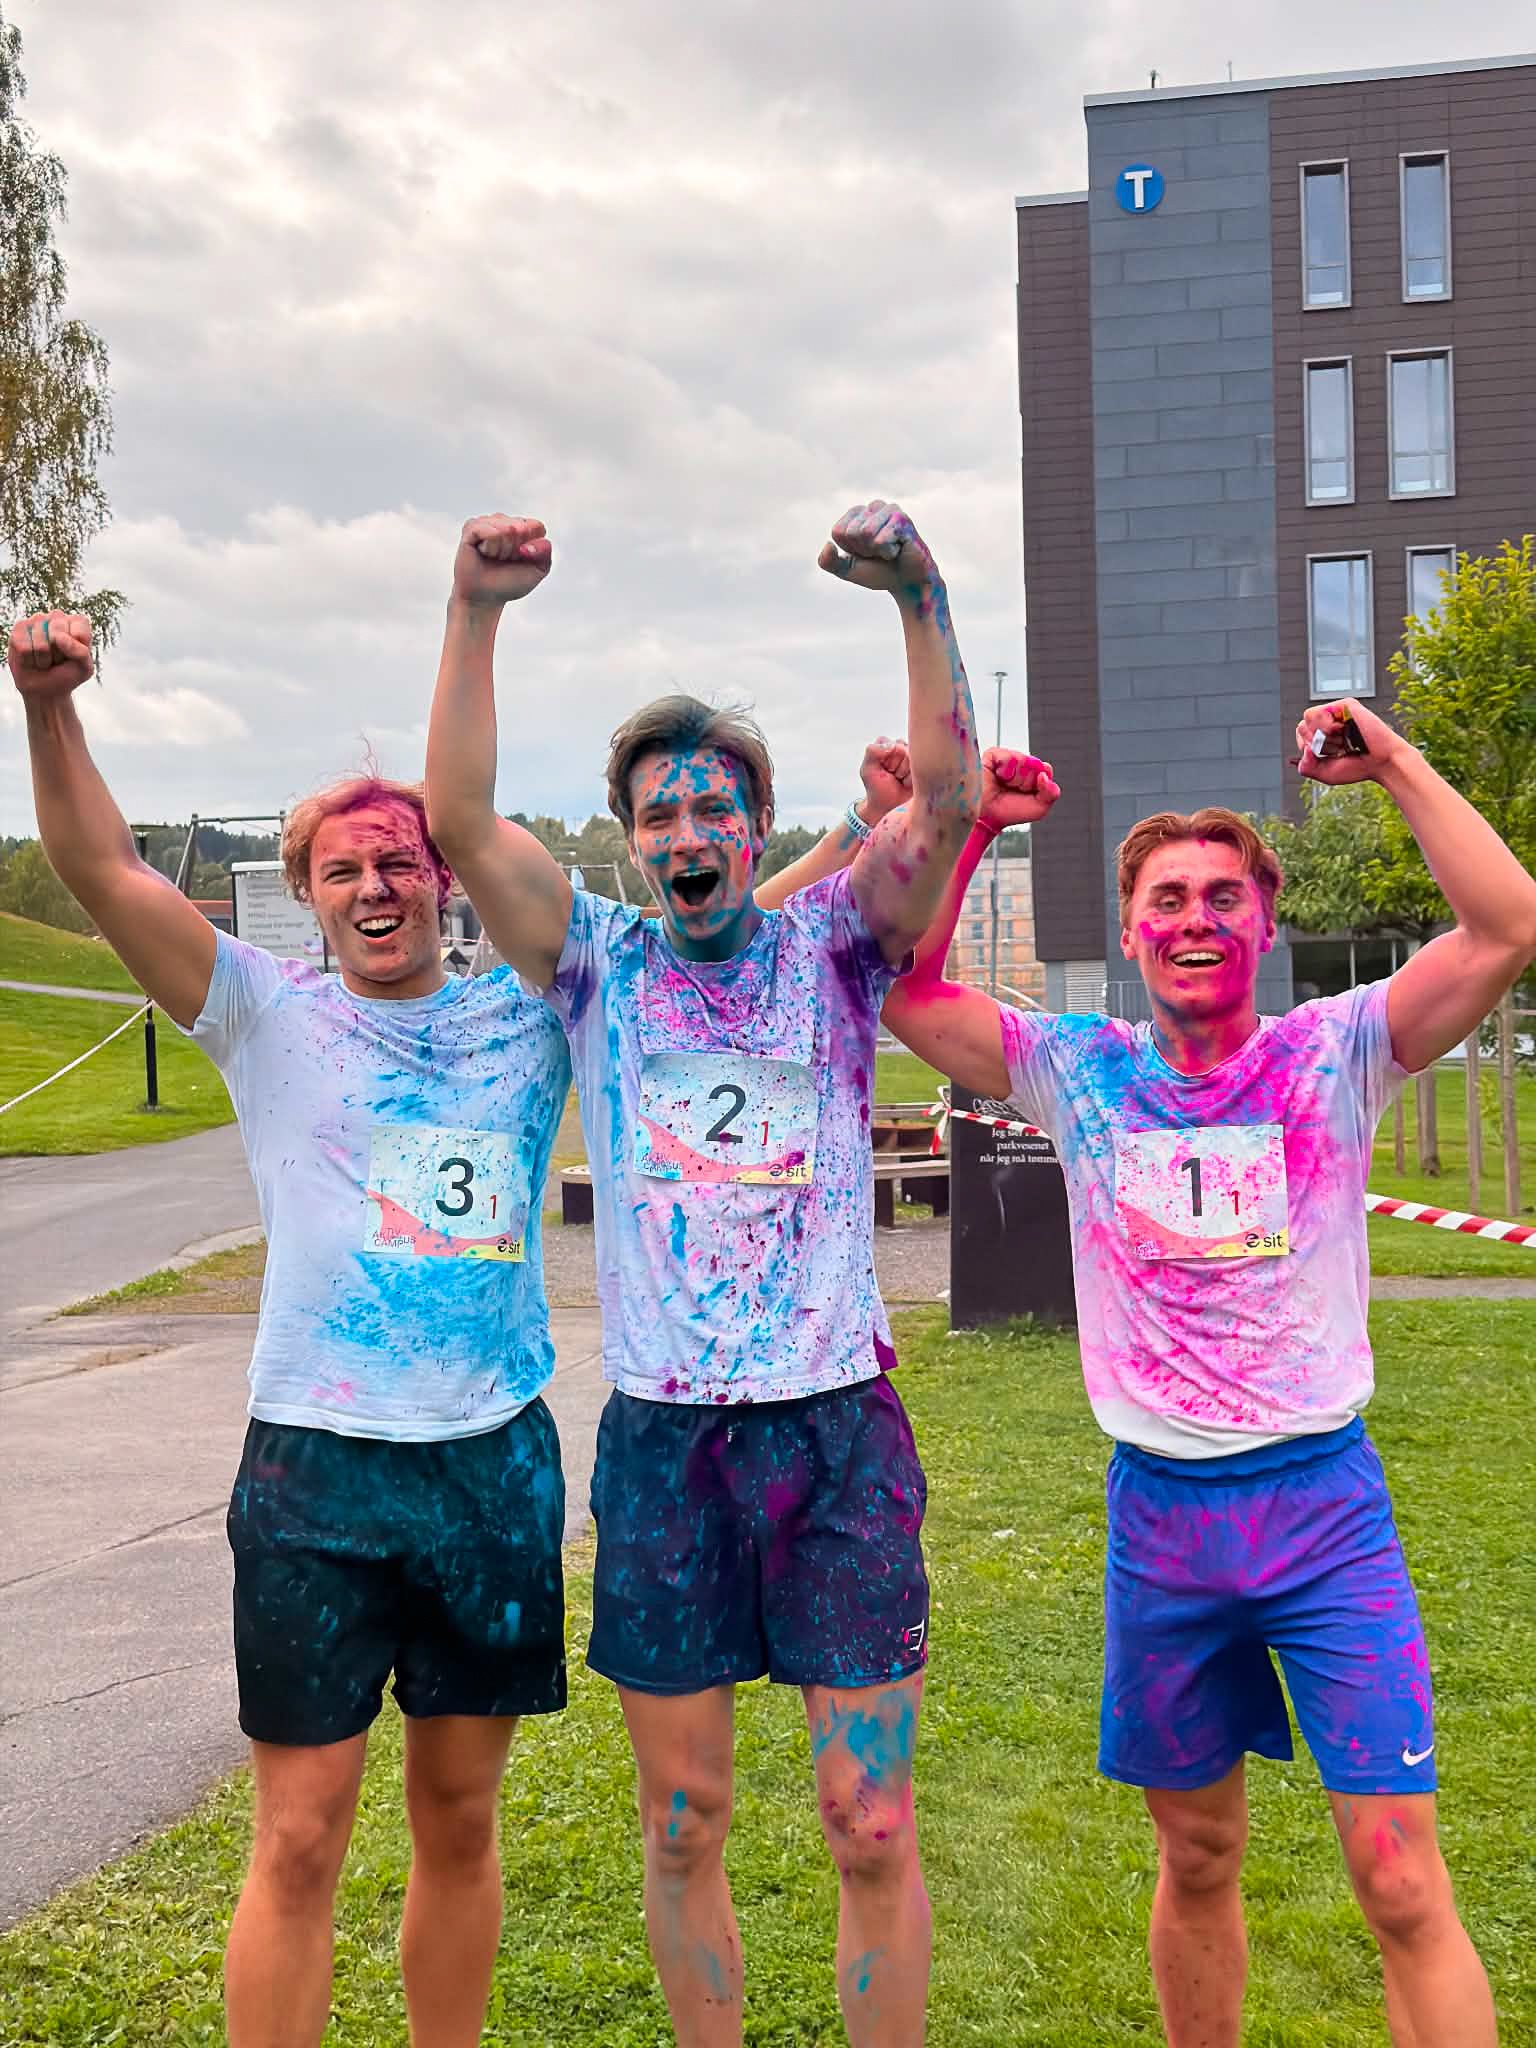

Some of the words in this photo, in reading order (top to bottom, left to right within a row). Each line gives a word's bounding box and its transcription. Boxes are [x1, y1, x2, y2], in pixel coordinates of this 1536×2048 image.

[1124, 170, 1153, 208] T
[704, 1083, 747, 1144] 2
[760, 1120, 769, 1146] 1
[435, 1157, 474, 1217] 3
[1181, 1157, 1203, 1217] 1
[1231, 1190, 1240, 1216] 1
[489, 1194, 497, 1220] 1
